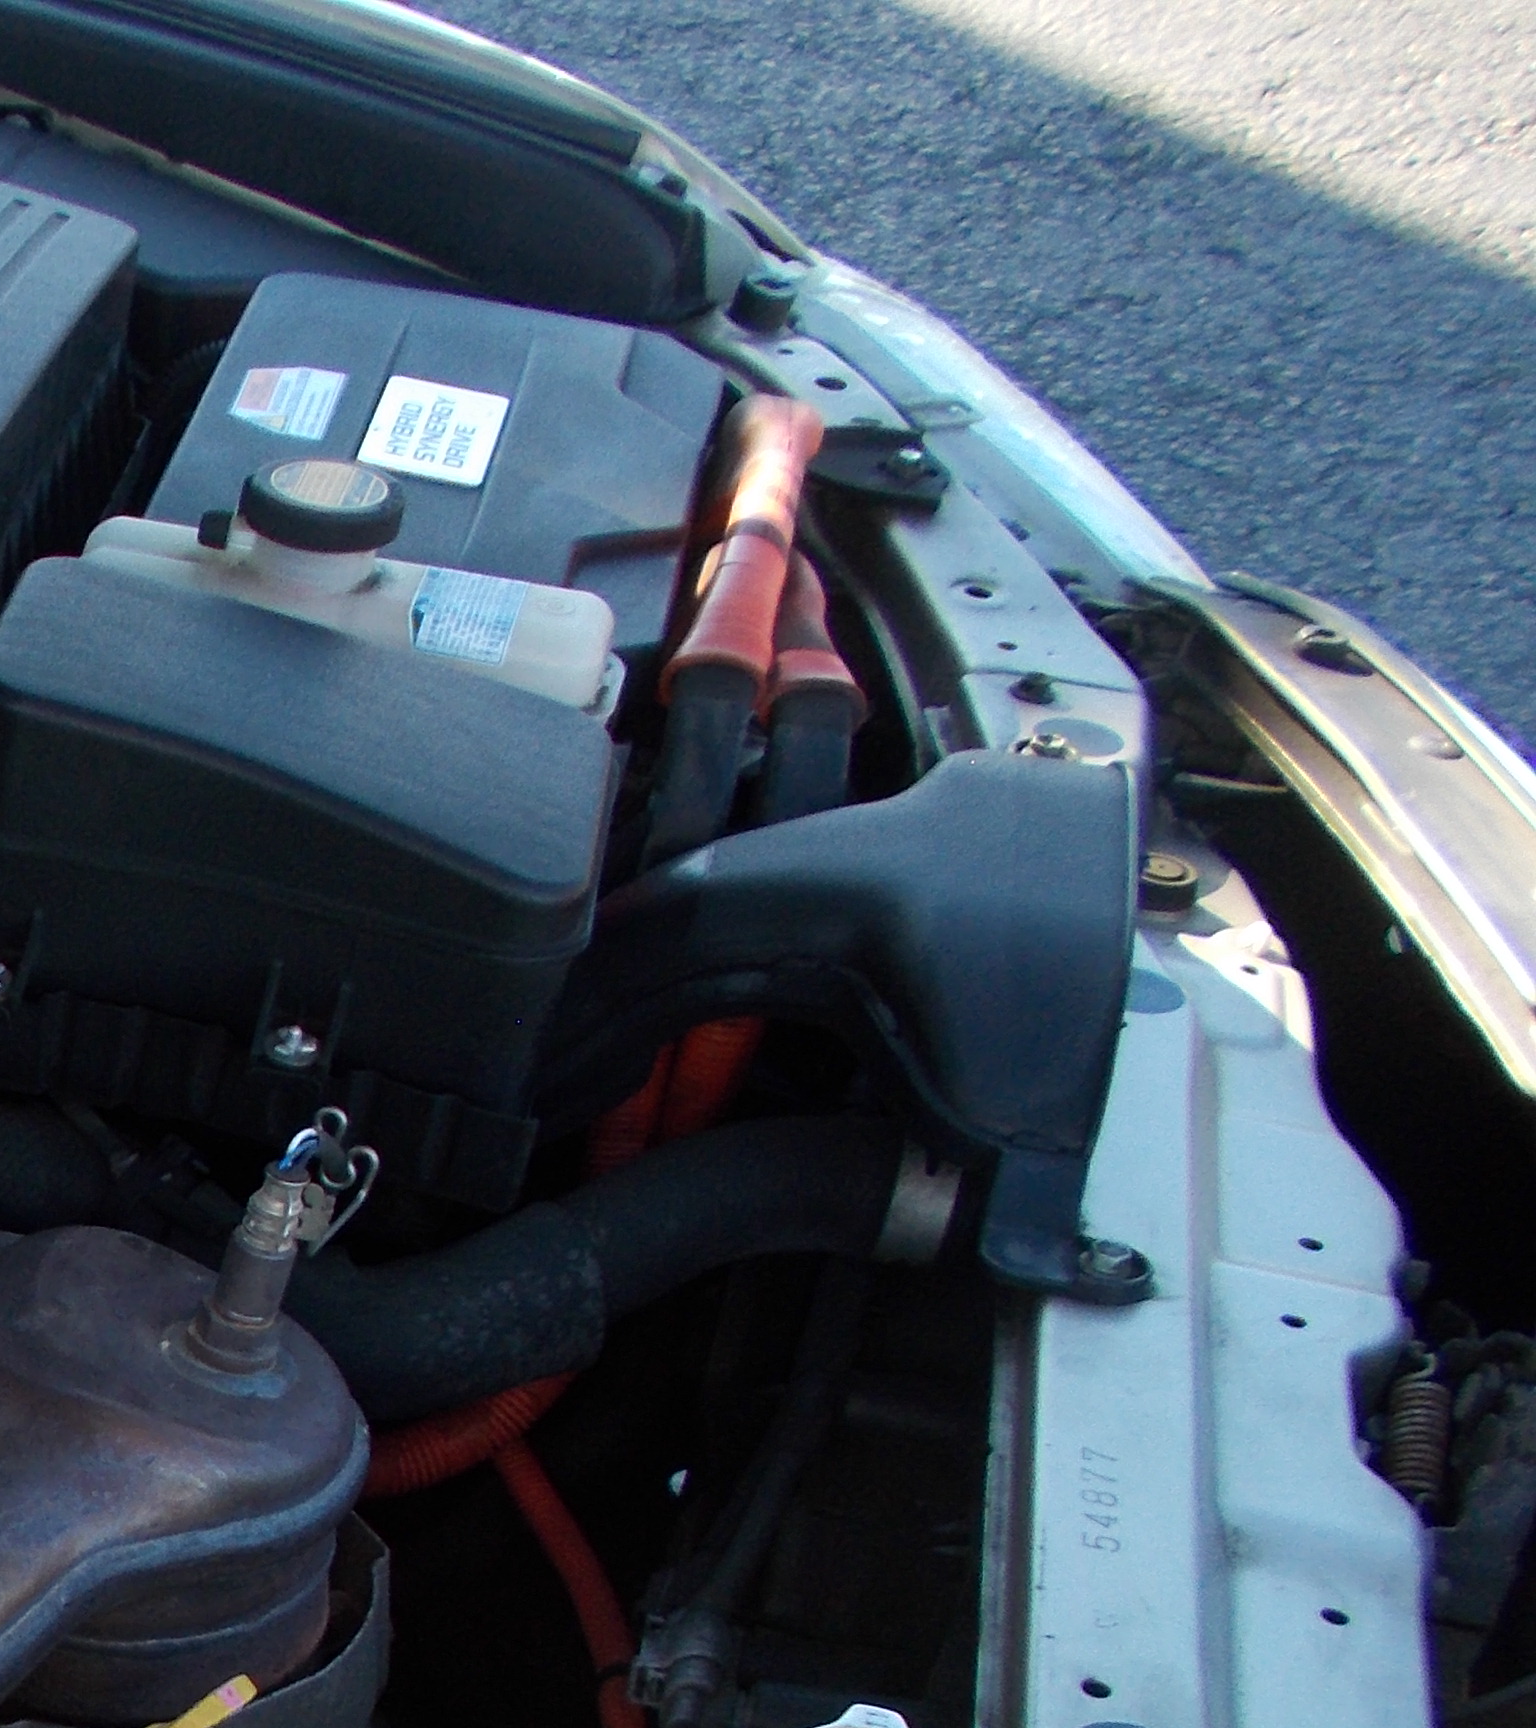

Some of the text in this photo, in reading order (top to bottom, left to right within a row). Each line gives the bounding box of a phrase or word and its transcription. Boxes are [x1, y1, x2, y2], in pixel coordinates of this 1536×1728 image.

[384, 400, 424, 457] HYBRID
[413, 395, 459, 464] SYNERGY
[442, 421, 477, 470] DRIVE
[1079, 1446, 1121, 1554] 54877
